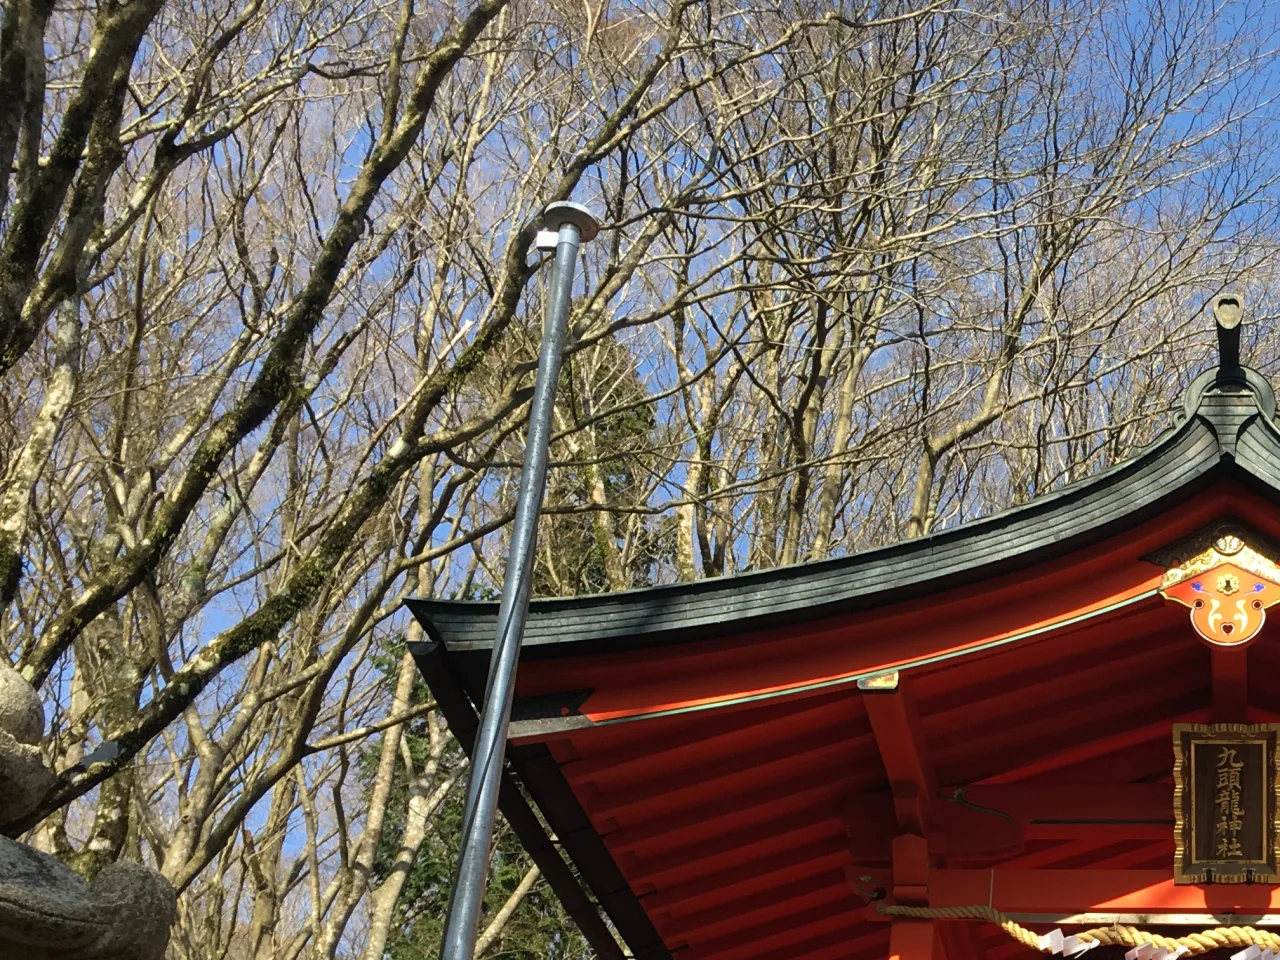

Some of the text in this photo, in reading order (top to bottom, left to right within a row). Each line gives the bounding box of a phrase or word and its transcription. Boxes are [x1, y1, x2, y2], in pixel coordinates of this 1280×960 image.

[1214, 746, 1246, 858] 九頭龍神社
